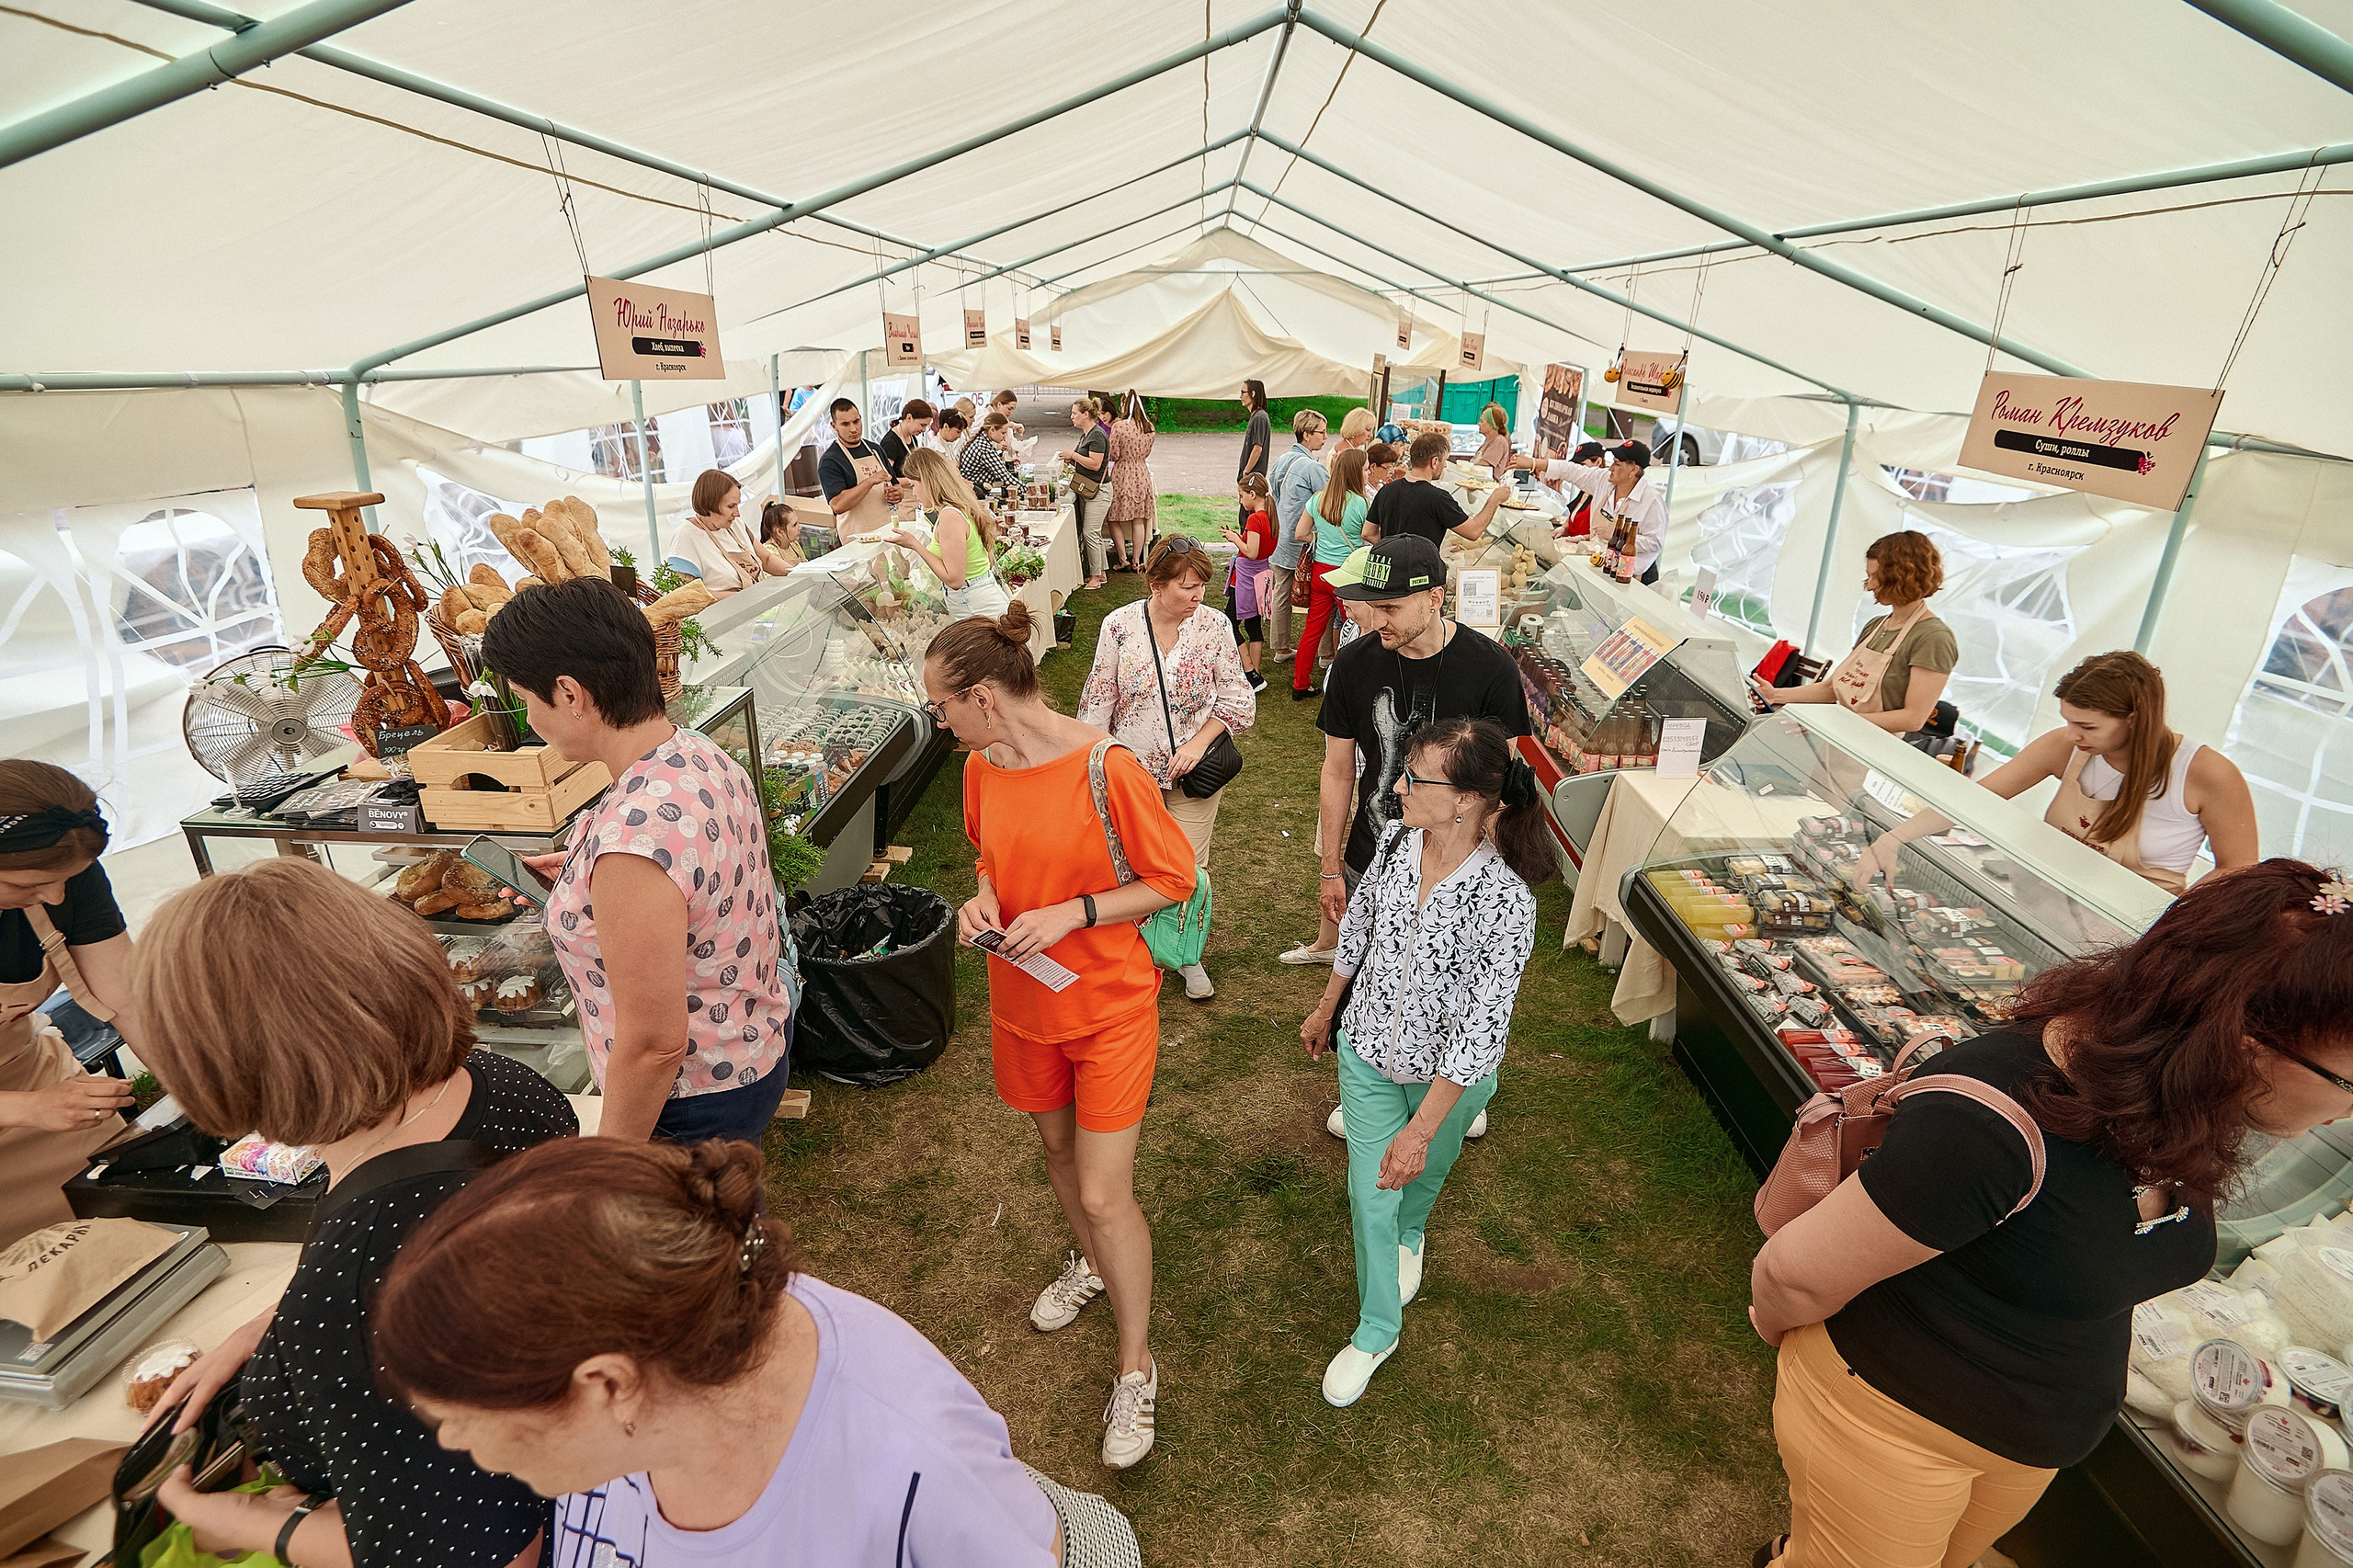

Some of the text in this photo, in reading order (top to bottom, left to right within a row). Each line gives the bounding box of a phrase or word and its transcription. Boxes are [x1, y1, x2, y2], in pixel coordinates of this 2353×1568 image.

[613, 297, 706, 339] Юрий Назарько
[651, 341, 685, 353] Хлеб, выпечка
[660, 362, 687, 373] Красноярск
[1991, 390, 2182, 447] Роман Кремзуков
[2034, 439, 2090, 459] Суши, роллы
[2028, 462, 2085, 481] г. Красноярск
[378, 729, 424, 742] Брецель
